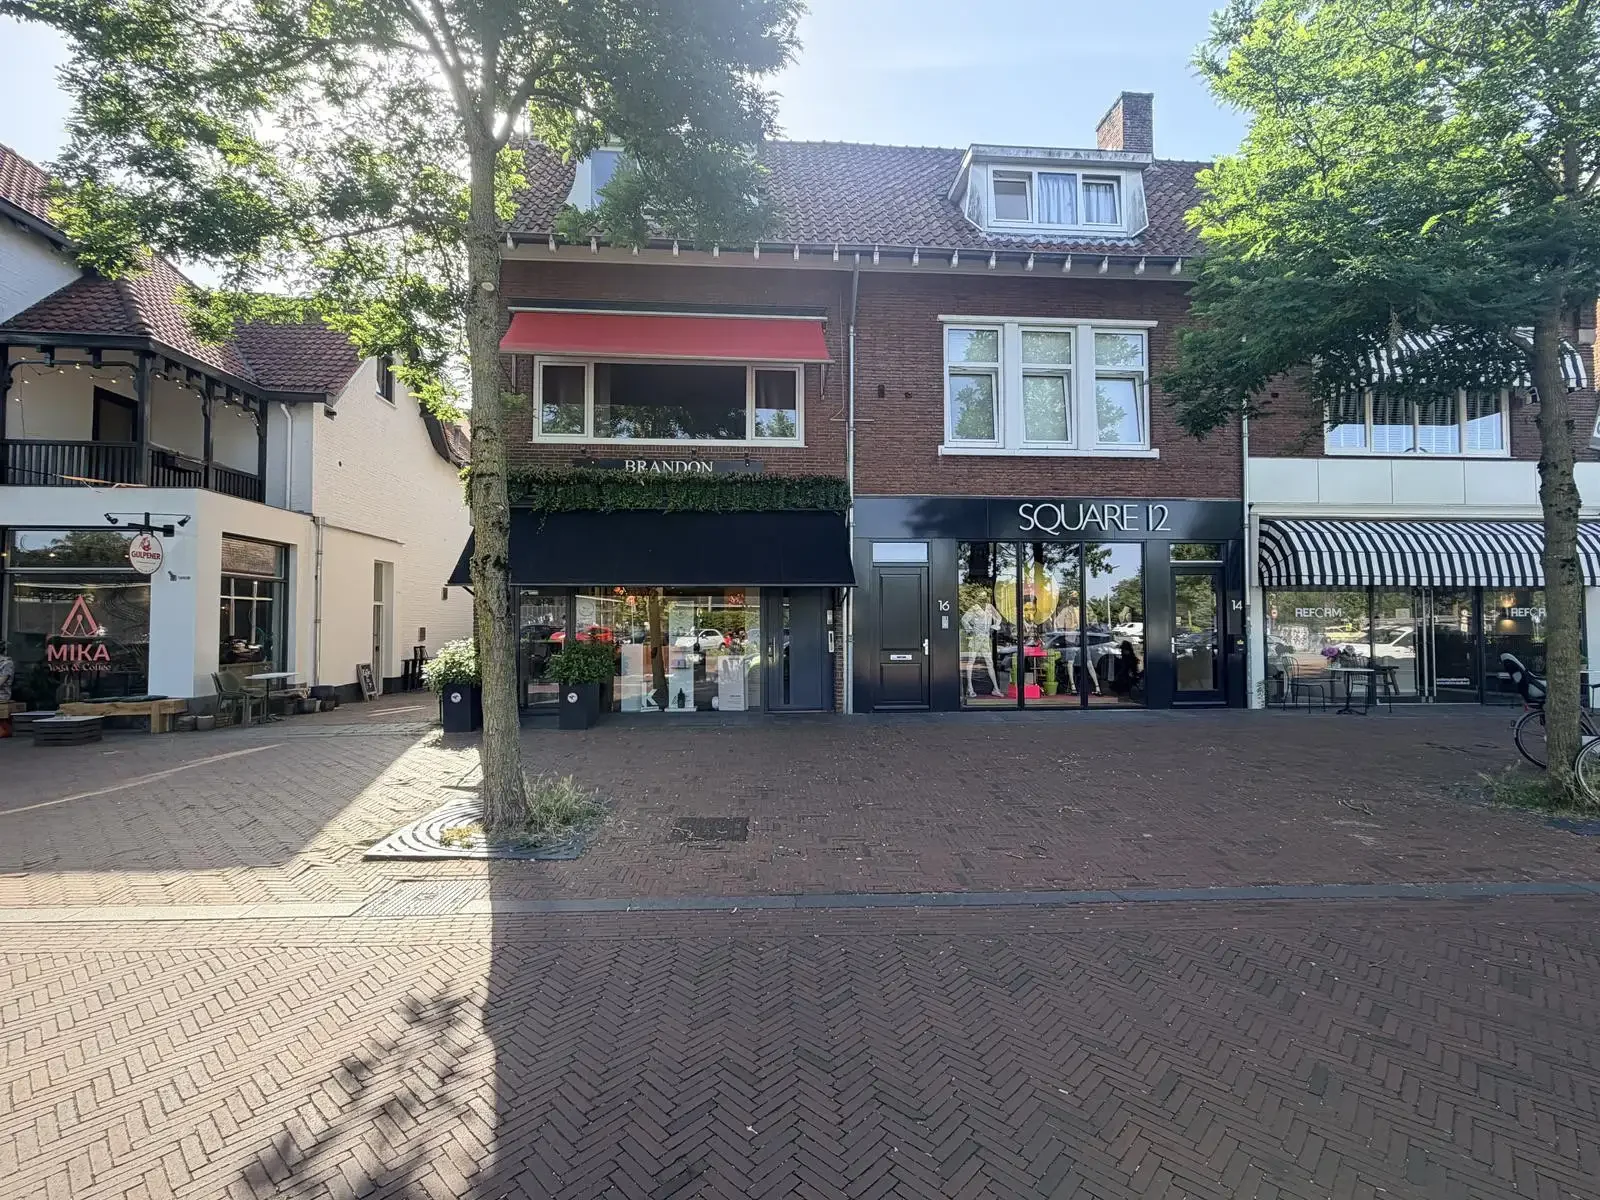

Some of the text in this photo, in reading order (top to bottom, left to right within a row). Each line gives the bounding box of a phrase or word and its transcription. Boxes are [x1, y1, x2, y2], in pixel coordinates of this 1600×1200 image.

[624, 459, 714, 474] BRANDON
[1018, 503, 1172, 536] SQUARE 12
[937, 599, 950, 611] 16
[1231, 599, 1243, 611] 14
[1295, 607, 1342, 618] REFORM
[1511, 607, 1547, 617] REFOR
[47, 643, 111, 662] MIKA
[48, 663, 69, 673] Yoga
[82, 663, 112, 672] Coffee
